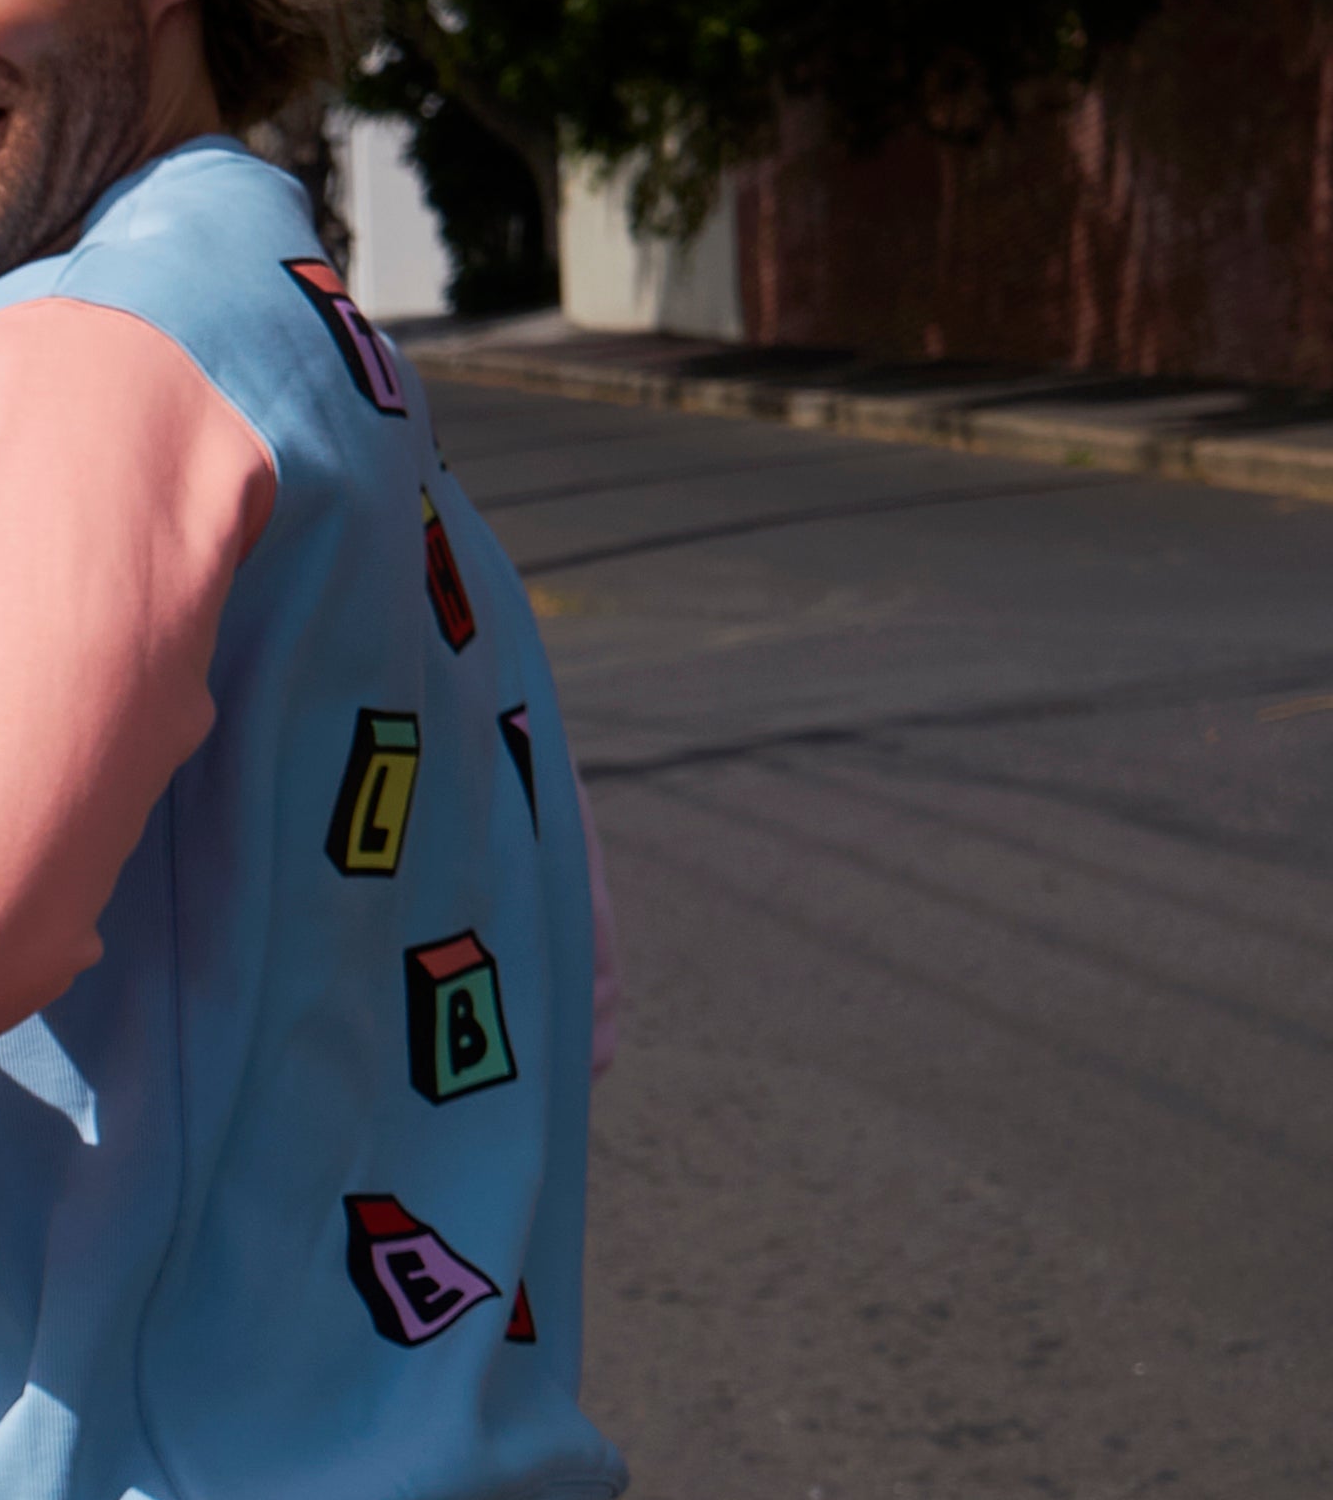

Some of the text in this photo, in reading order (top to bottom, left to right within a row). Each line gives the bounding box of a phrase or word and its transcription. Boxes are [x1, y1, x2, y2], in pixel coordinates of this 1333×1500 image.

[359, 765, 390, 853] L
[448, 989, 488, 1076] B
[386, 1250, 465, 1324] E
